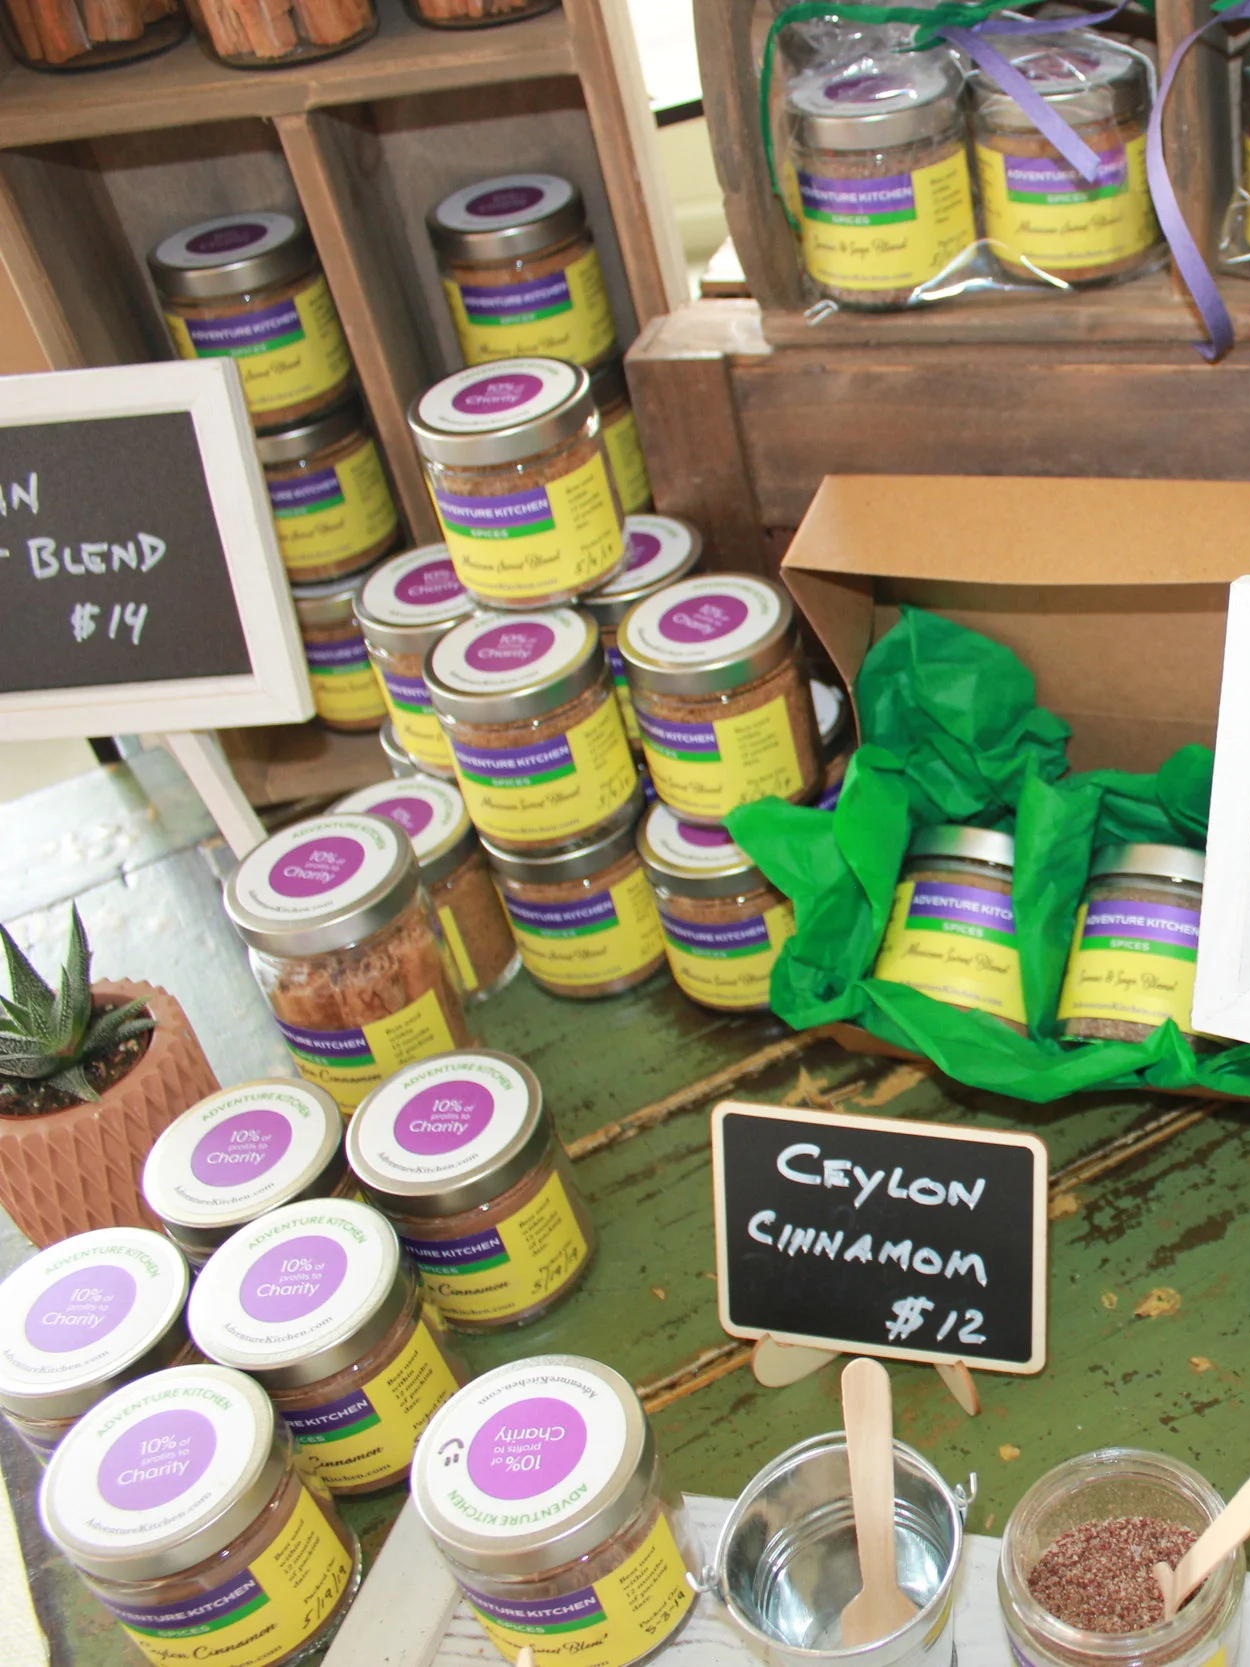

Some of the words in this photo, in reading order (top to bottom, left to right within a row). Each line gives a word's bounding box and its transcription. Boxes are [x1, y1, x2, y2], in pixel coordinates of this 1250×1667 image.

[858, 186, 912, 202] KITCHEN
[1046, 192, 1088, 204] SPICES
[832, 215, 870, 225] SPICES
[494, 499, 549, 518] KITCHEN
[470, 527, 509, 539] SPICES
[26, 532, 167, 579] BLEND
[478, 644, 532, 661] Charity
[666, 731, 715, 745] KITCHEN
[518, 745, 570, 766] KITCHEN
[491, 777, 531, 787] SPICES
[292, 823, 358, 840] ADVENTURE
[309, 850, 336, 863] 10%
[283, 867, 335, 883] Charity
[563, 901, 613, 921] KITCHEN
[913, 895, 978, 914] ADVENTURE
[714, 926, 766, 942] KITCHEN
[943, 922, 984, 937] SPICES
[1086, 914, 1145, 928] ADVENTURE
[1146, 918, 1200, 937] KITCHEN
[1109, 938, 1150, 951] SPICES
[317, 1037, 366, 1050] KITCHEN
[202, 1092, 275, 1122] ADVENTURE
[432, 1099, 463, 1112] 10%
[409, 1119, 468, 1135] Charity
[207, 1151, 265, 1165] Charity
[776, 1143, 986, 1210] CEYLON
[440, 1237, 500, 1258] KITCHEN
[747, 1209, 988, 1287] CINNAMOM
[280, 1258, 313, 1273] 10%
[256, 1281, 320, 1298] Charity
[438, 1280, 511, 1296] Cinnamon
[42, 1311, 105, 1329] Charity
[885, 1296, 987, 1344] $12
[97, 1387, 180, 1437] ADVENTURE
[182, 1387, 233, 1412] KITCHEN
[304, 1399, 369, 1428] KITCHEN
[494, 1425, 567, 1442] Charity
[140, 1434, 176, 1455] 10%
[308, 1446, 384, 1468] Cinnamon
[504, 1454, 542, 1473] 10%
[117, 1459, 190, 1486] Charity
[448, 1489, 499, 1526] KITCHEN
[499, 1483, 590, 1527] ADVENTURE
[186, 1579, 256, 1619] KITCHEN
[302, 1564, 348, 1630] 5/19/19
[527, 1596, 597, 1618] KITCHEN
[193, 1621, 278, 1660] Cinnamon
